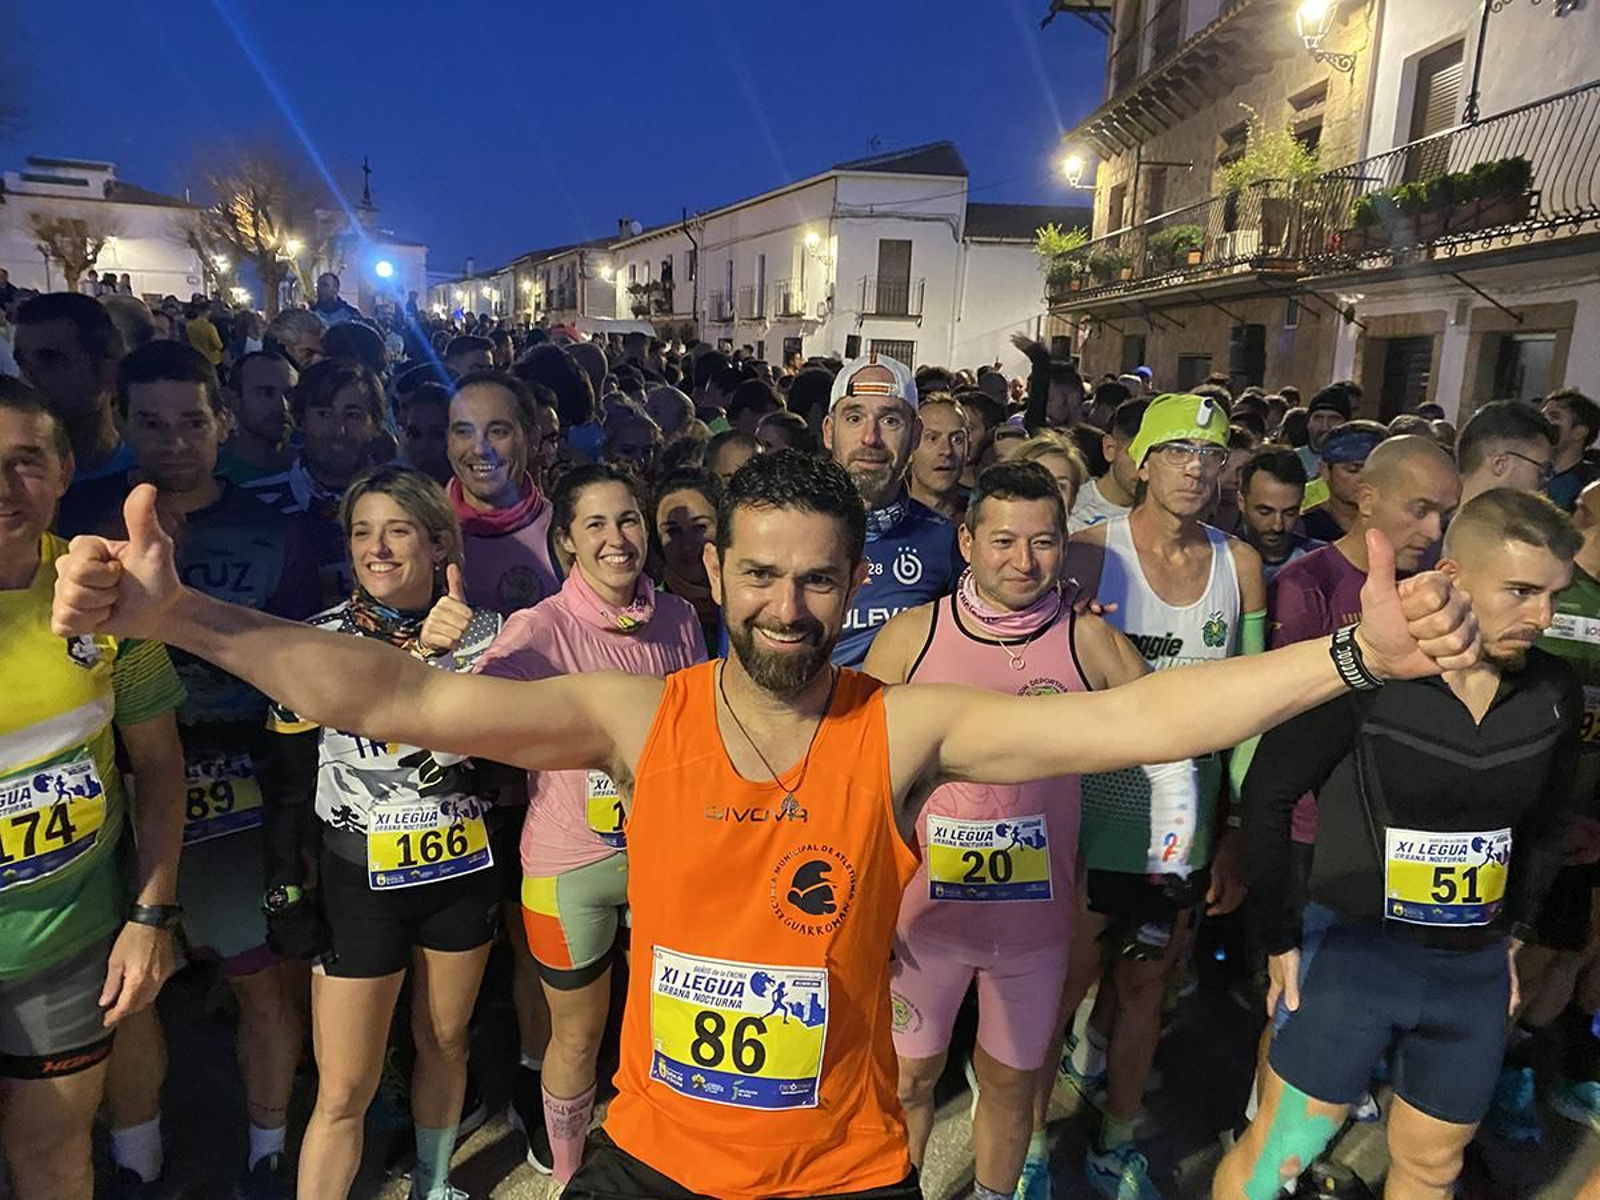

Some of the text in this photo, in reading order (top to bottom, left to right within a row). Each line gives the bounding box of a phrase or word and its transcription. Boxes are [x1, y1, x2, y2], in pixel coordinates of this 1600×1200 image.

[594, 779, 610, 790] XI
[376, 811, 438, 825] XI LEGUA
[396, 824, 469, 867] 166
[934, 826, 993, 842] XI LEGUA
[820, 844, 834, 855] DE
[1396, 841, 1468, 856] XI LEGUA
[962, 849, 1014, 884] 20
[1431, 866, 1483, 903] 51
[660, 966, 745, 999] XI LEGUA
[658, 984, 743, 1009] URBANA NOCTURNA
[690, 1010, 768, 1075] 86
